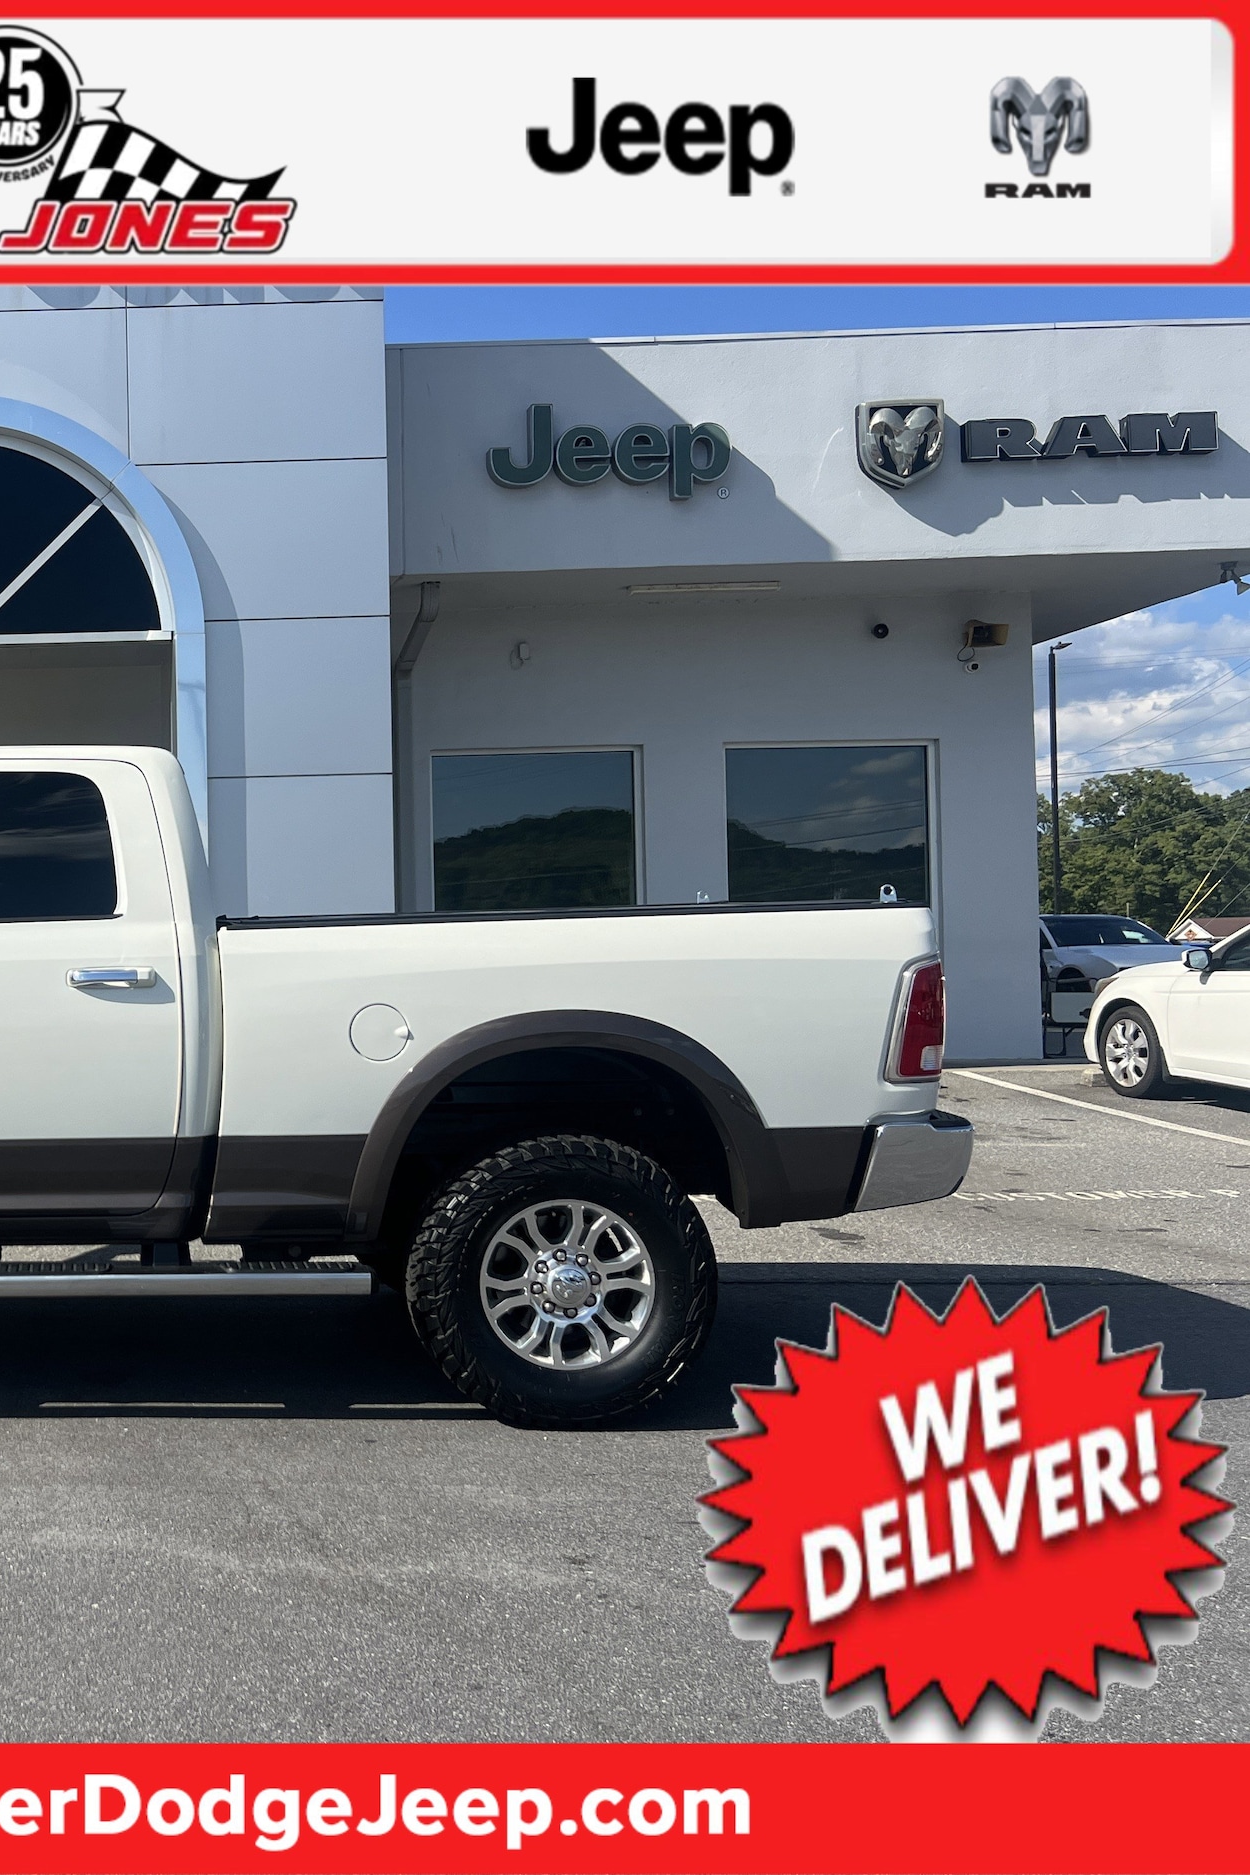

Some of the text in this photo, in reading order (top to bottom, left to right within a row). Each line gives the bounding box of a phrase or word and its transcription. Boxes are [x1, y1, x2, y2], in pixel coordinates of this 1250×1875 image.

[486, 403, 731, 500] Jeep
[960, 411, 1218, 462] RAM
[952, 1189, 1205, 1201] CUSTOMER
